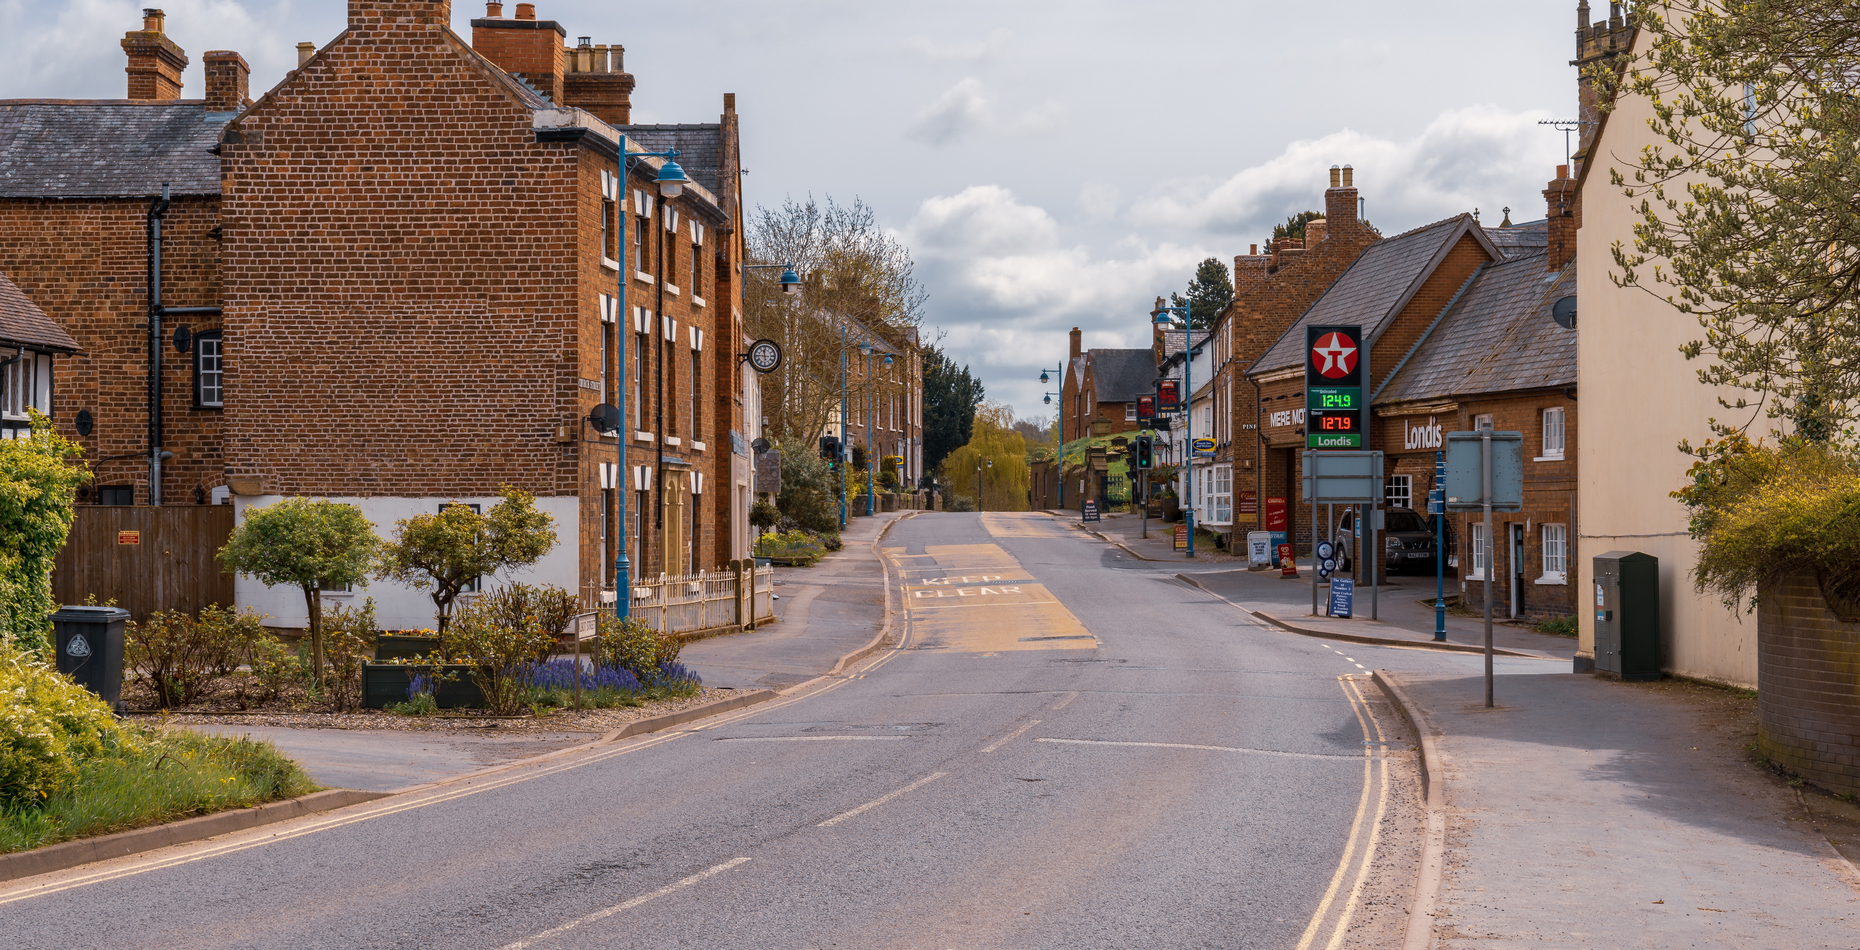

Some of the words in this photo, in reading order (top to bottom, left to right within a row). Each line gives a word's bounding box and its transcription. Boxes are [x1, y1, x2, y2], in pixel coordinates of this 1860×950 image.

[1322, 395, 1350, 407] 124.9
[1270, 410, 1290, 427] MERE
[1292, 408, 1306, 425] MO
[1322, 417, 1350, 430] 127.9
[1405, 416, 1442, 449] Londis
[1318, 437, 1351, 446] Londis
[922, 576, 1000, 585] KEEP
[915, 586, 1022, 598] CLEAR
